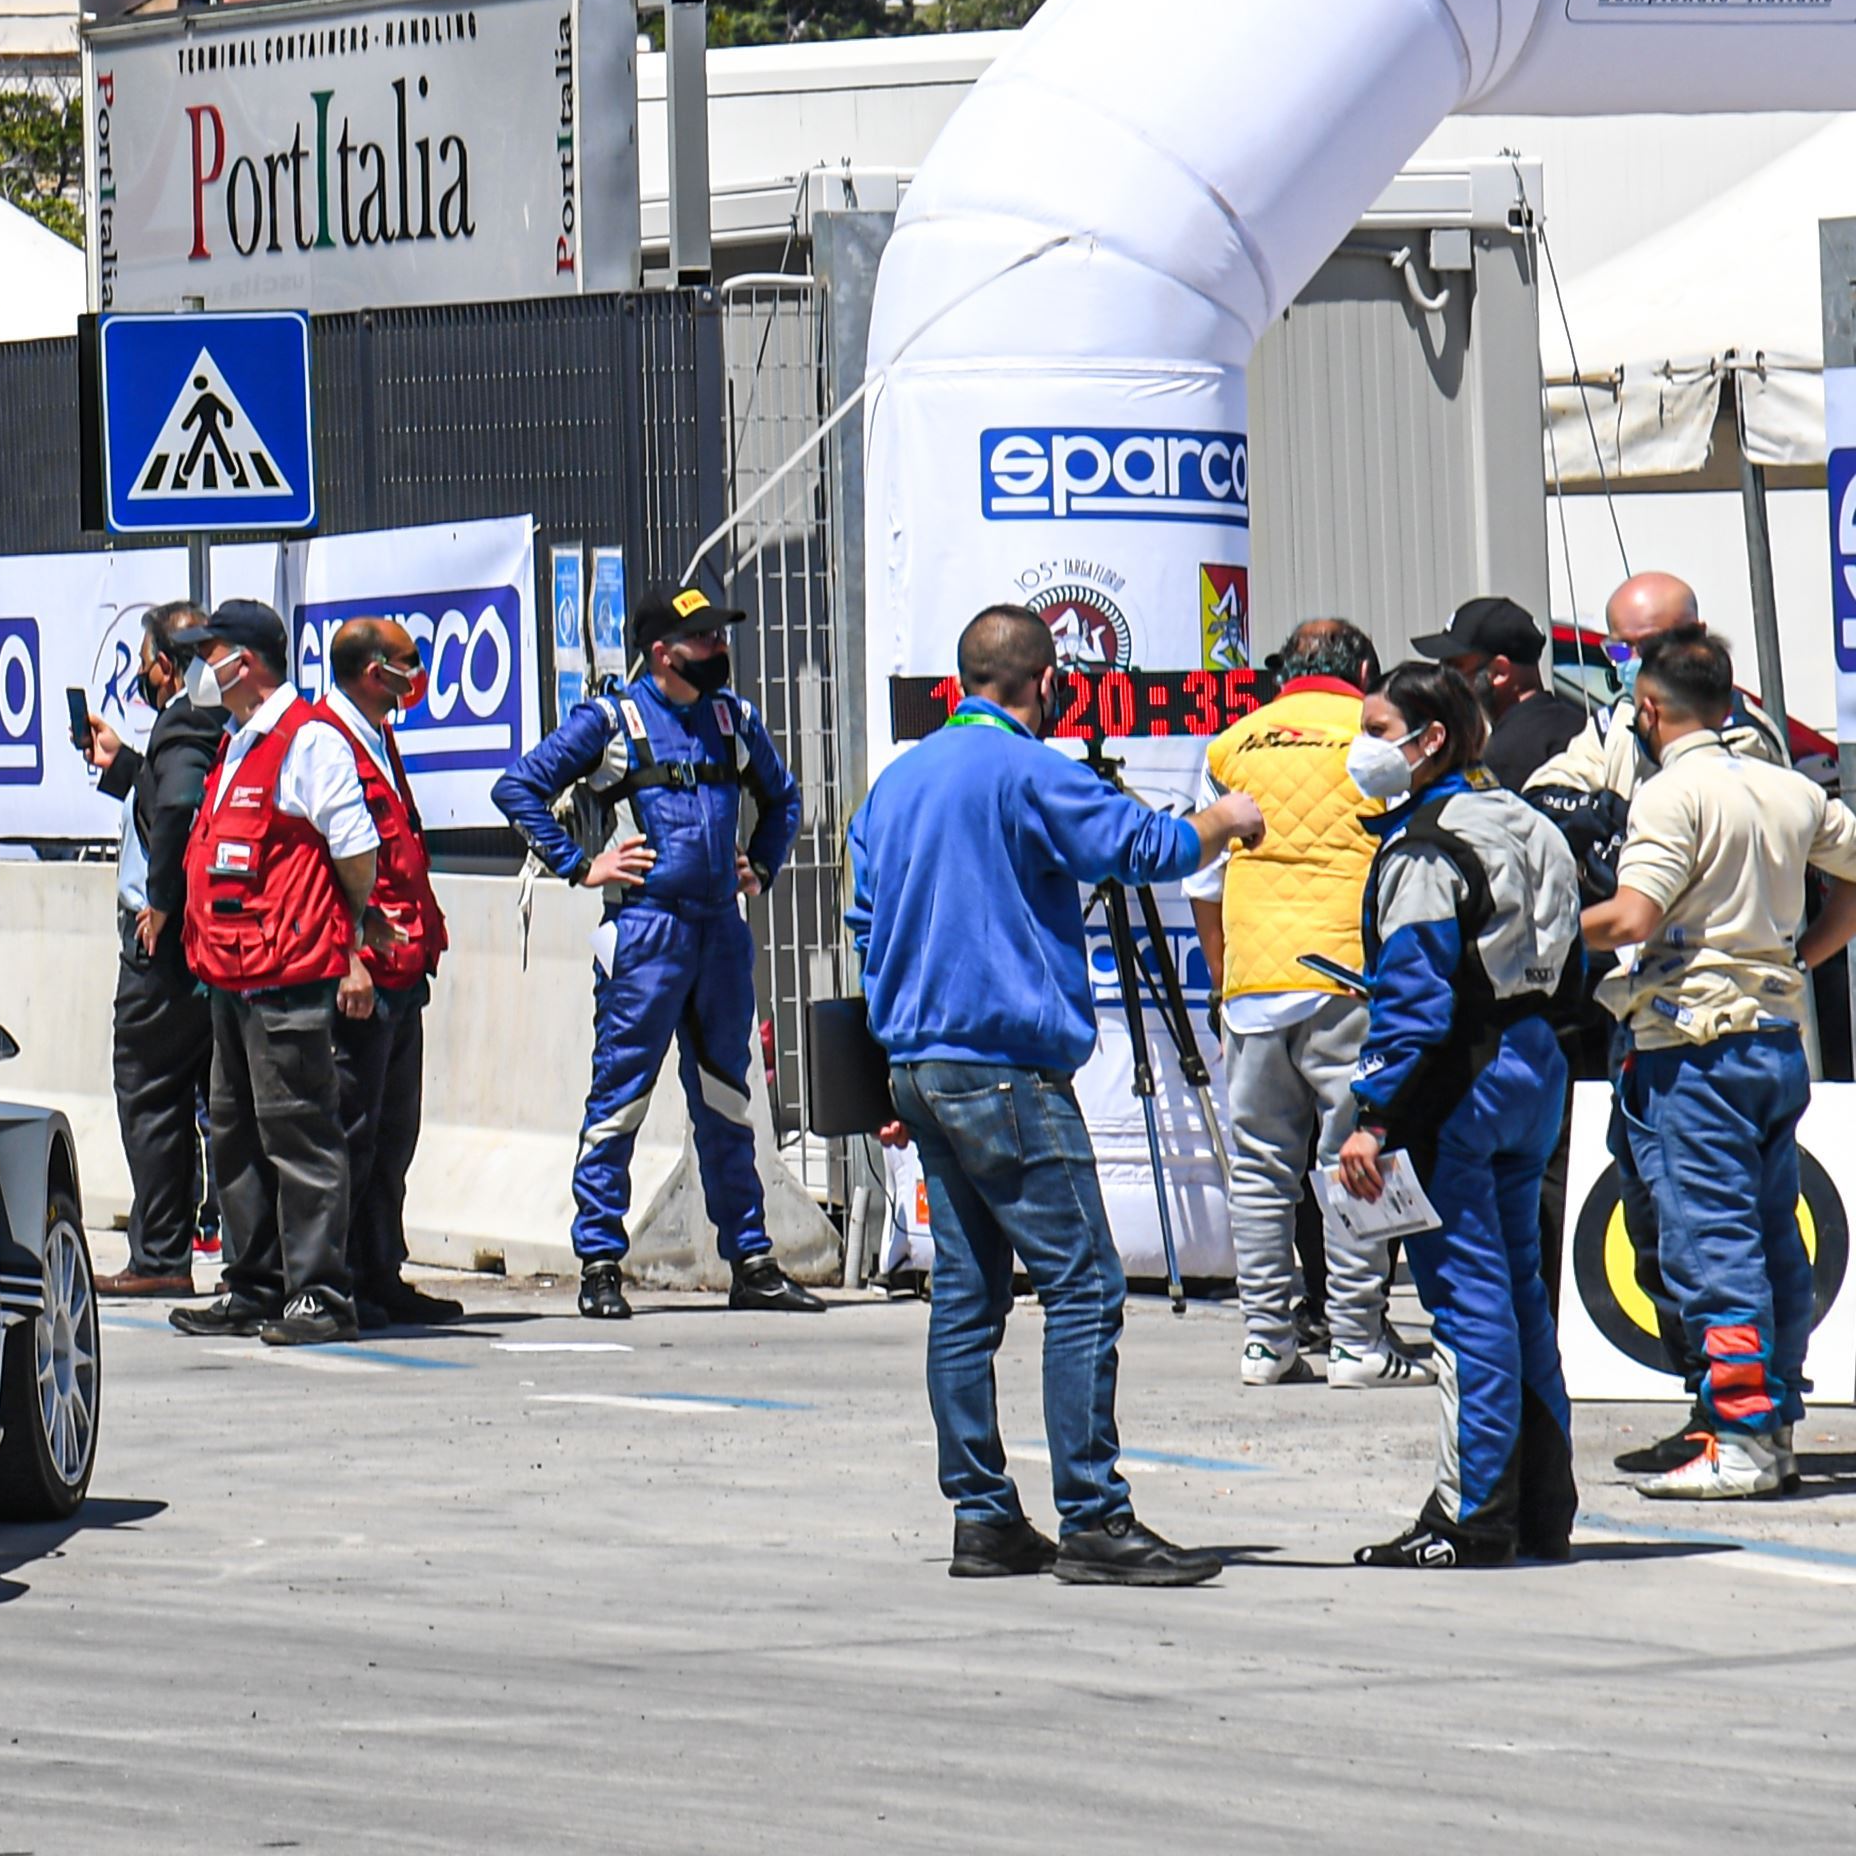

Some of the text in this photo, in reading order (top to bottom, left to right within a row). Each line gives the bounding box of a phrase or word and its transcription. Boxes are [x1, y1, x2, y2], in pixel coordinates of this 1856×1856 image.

[177, 46, 257, 76] TERMINAL
[264, 24, 369, 64] CONTAINERS
[385, 11, 478, 49] HANDLING
[184, 75, 476, 261] PortItalia
[990, 434, 1248, 518] sparco
[1064, 558, 1093, 579] TARGA
